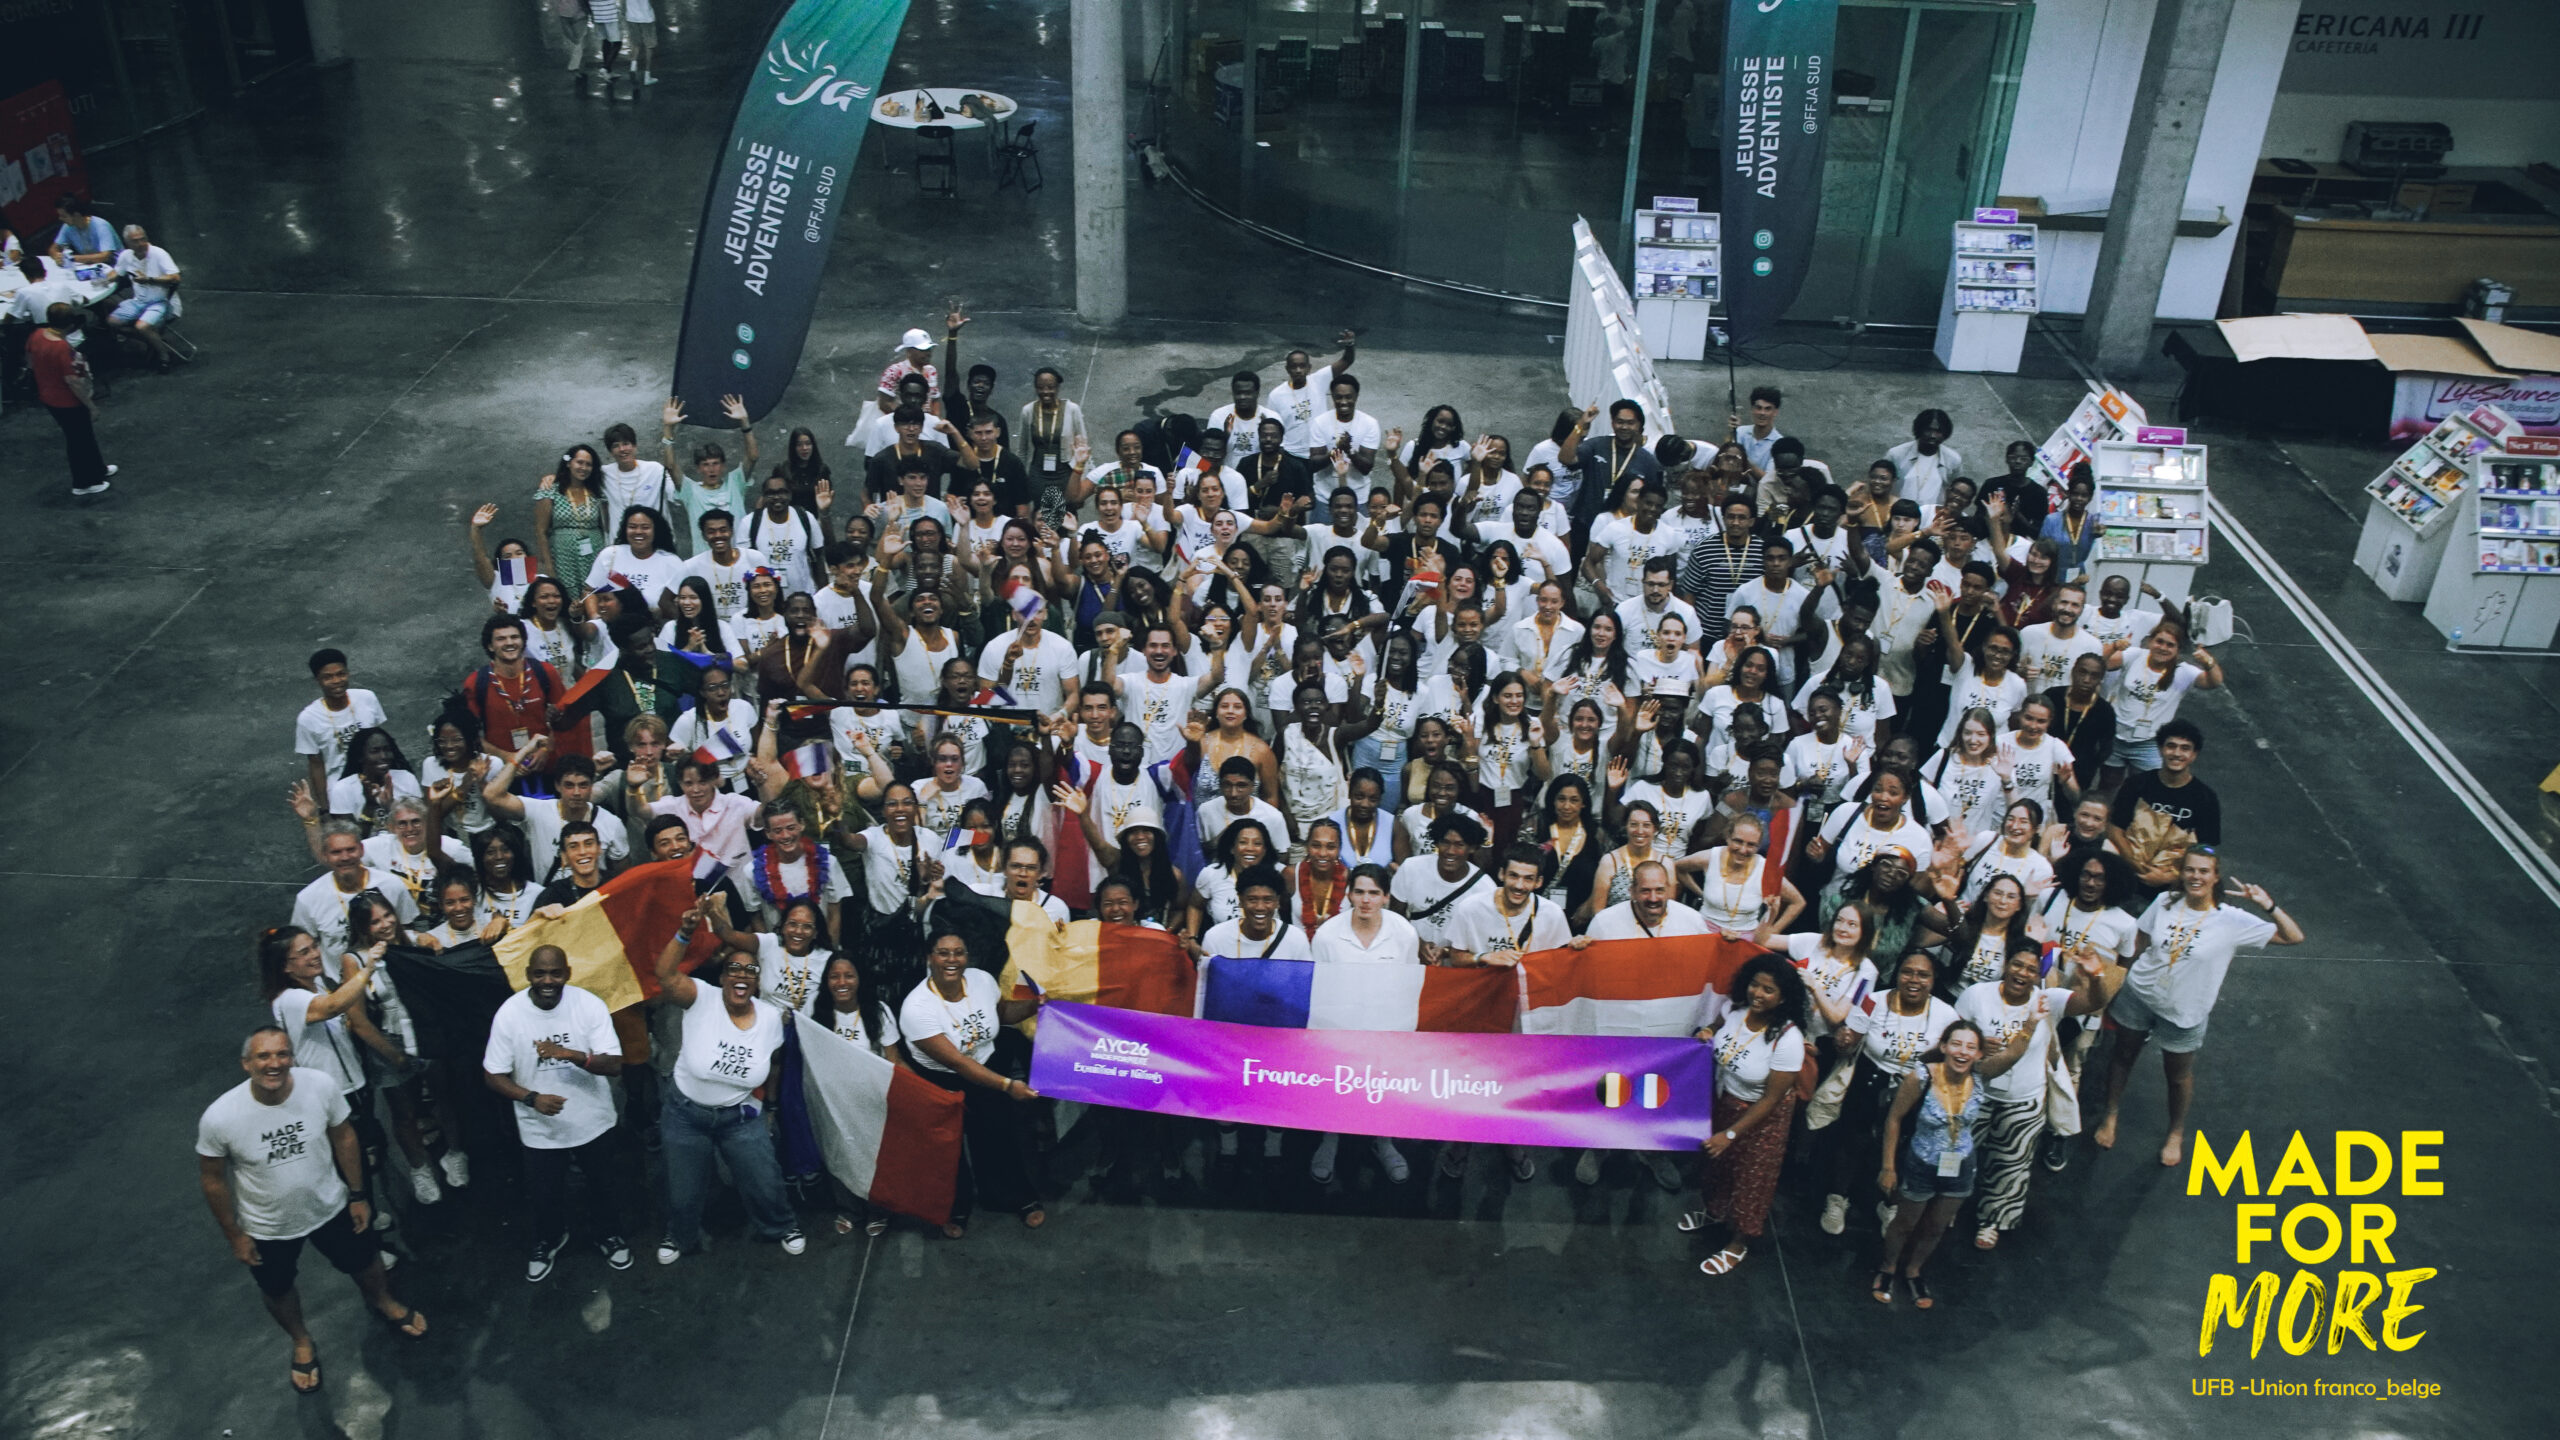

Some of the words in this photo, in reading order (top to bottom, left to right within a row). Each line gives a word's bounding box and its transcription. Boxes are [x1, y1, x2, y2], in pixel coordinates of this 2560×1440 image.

[2294, 14, 2430, 39] ERICANA
[2442, 14, 2484, 40] III
[1807, 55, 1821, 84] SUD
[1736, 56, 1761, 178] JEUNESSE
[1802, 87, 1819, 134] @FFJA
[1757, 56, 1785, 199] ADVENTISTE
[724, 142, 773, 266] JEUNESSE
[804, 196, 829, 243] @FFJA
[819, 165, 837, 196] SUD
[744, 150, 801, 297] ADVENTISTE
[1955, 778, 1986, 789] MADE
[836, 1027, 860, 1041] ADE
[718, 1041, 754, 1058] MADE
[1092, 1037, 1151, 1056] AYC26
[1882, 1048, 1923, 1062] MOE
[711, 1060, 751, 1079] MORE
[722, 1052, 745, 1067] FOR
[1242, 1058, 1422, 1104] Franco-Belgian
[1429, 1068, 1503, 1099] Union
[261, 1120, 304, 1142] MADE
[270, 1135, 298, 1150] FOR
[267, 1141, 306, 1164] MORE
